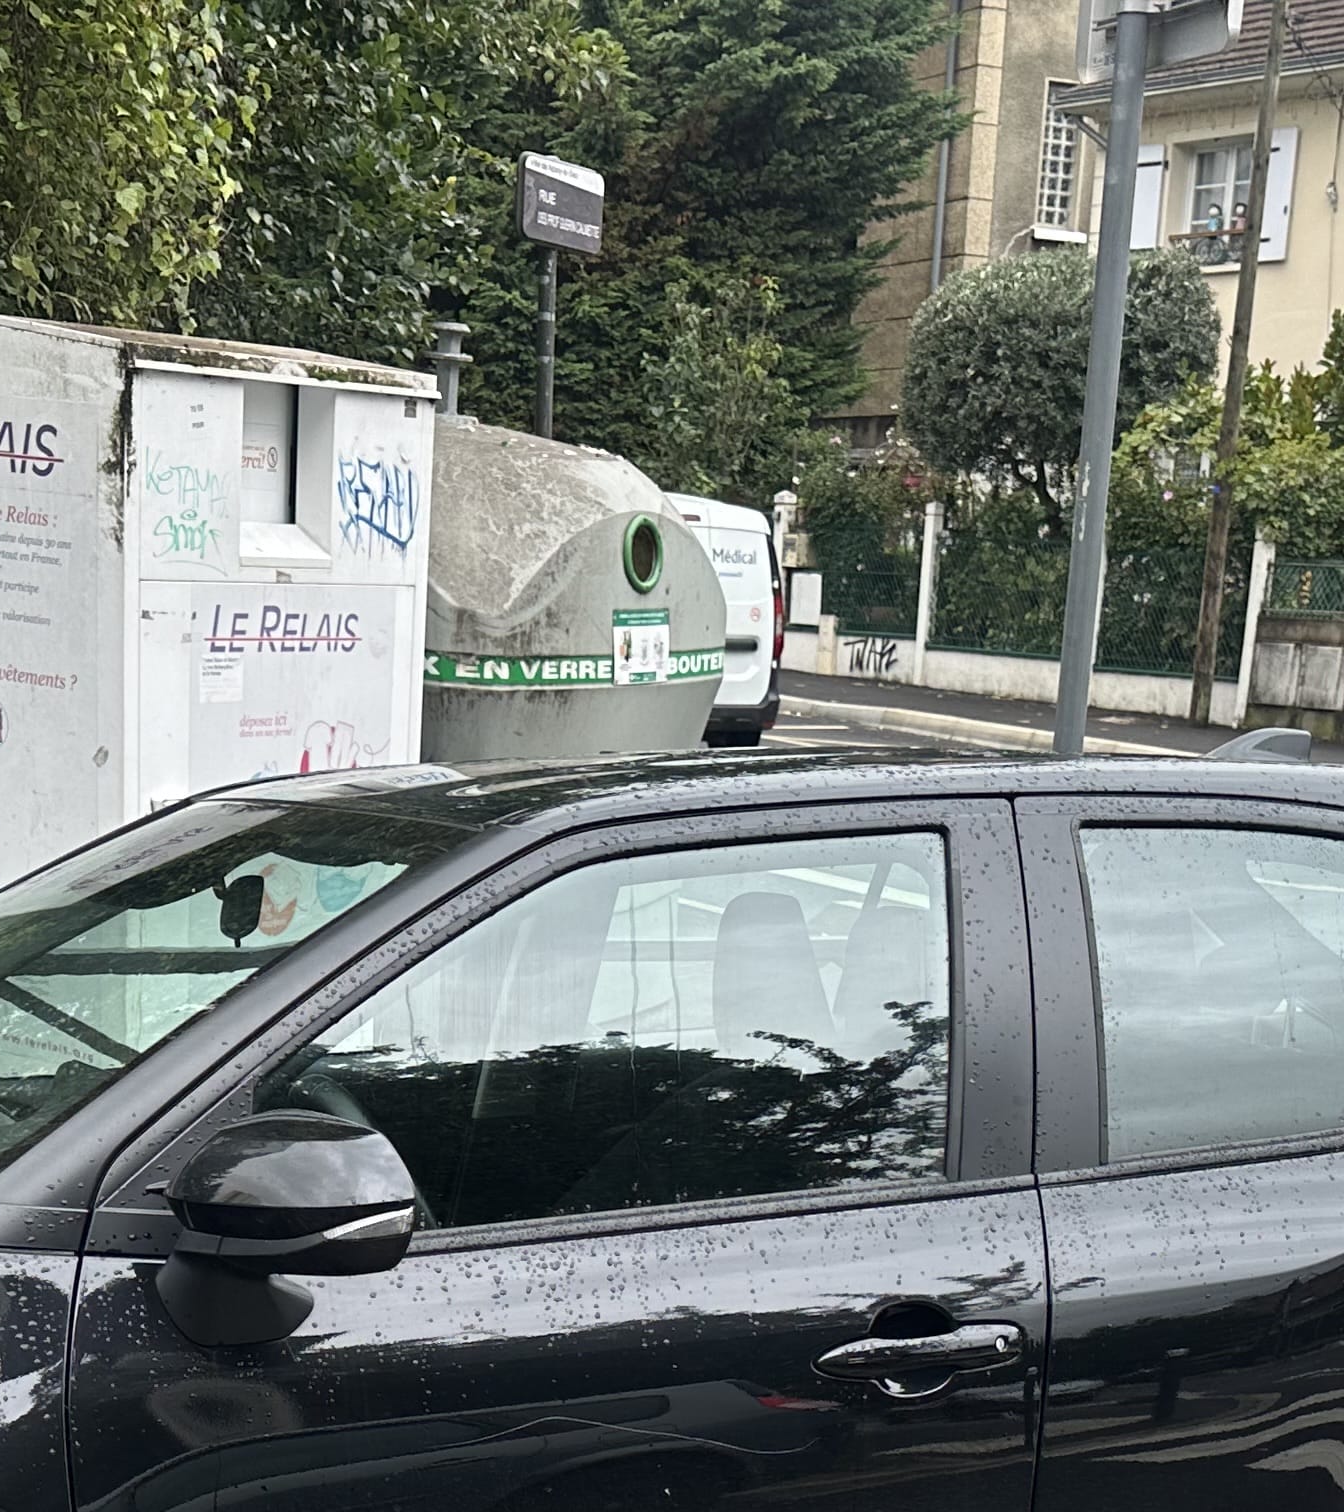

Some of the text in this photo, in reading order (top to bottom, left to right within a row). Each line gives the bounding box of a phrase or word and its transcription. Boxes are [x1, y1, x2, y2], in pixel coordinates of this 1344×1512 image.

[6, 505, 49, 526] Relais
[712, 548, 757, 565] Médical
[209, 604, 359, 652] LE RELAIS
[455, 655, 510, 679] EN
[519, 660, 613, 680] VERRE
[69, 674, 78, 691] ?
